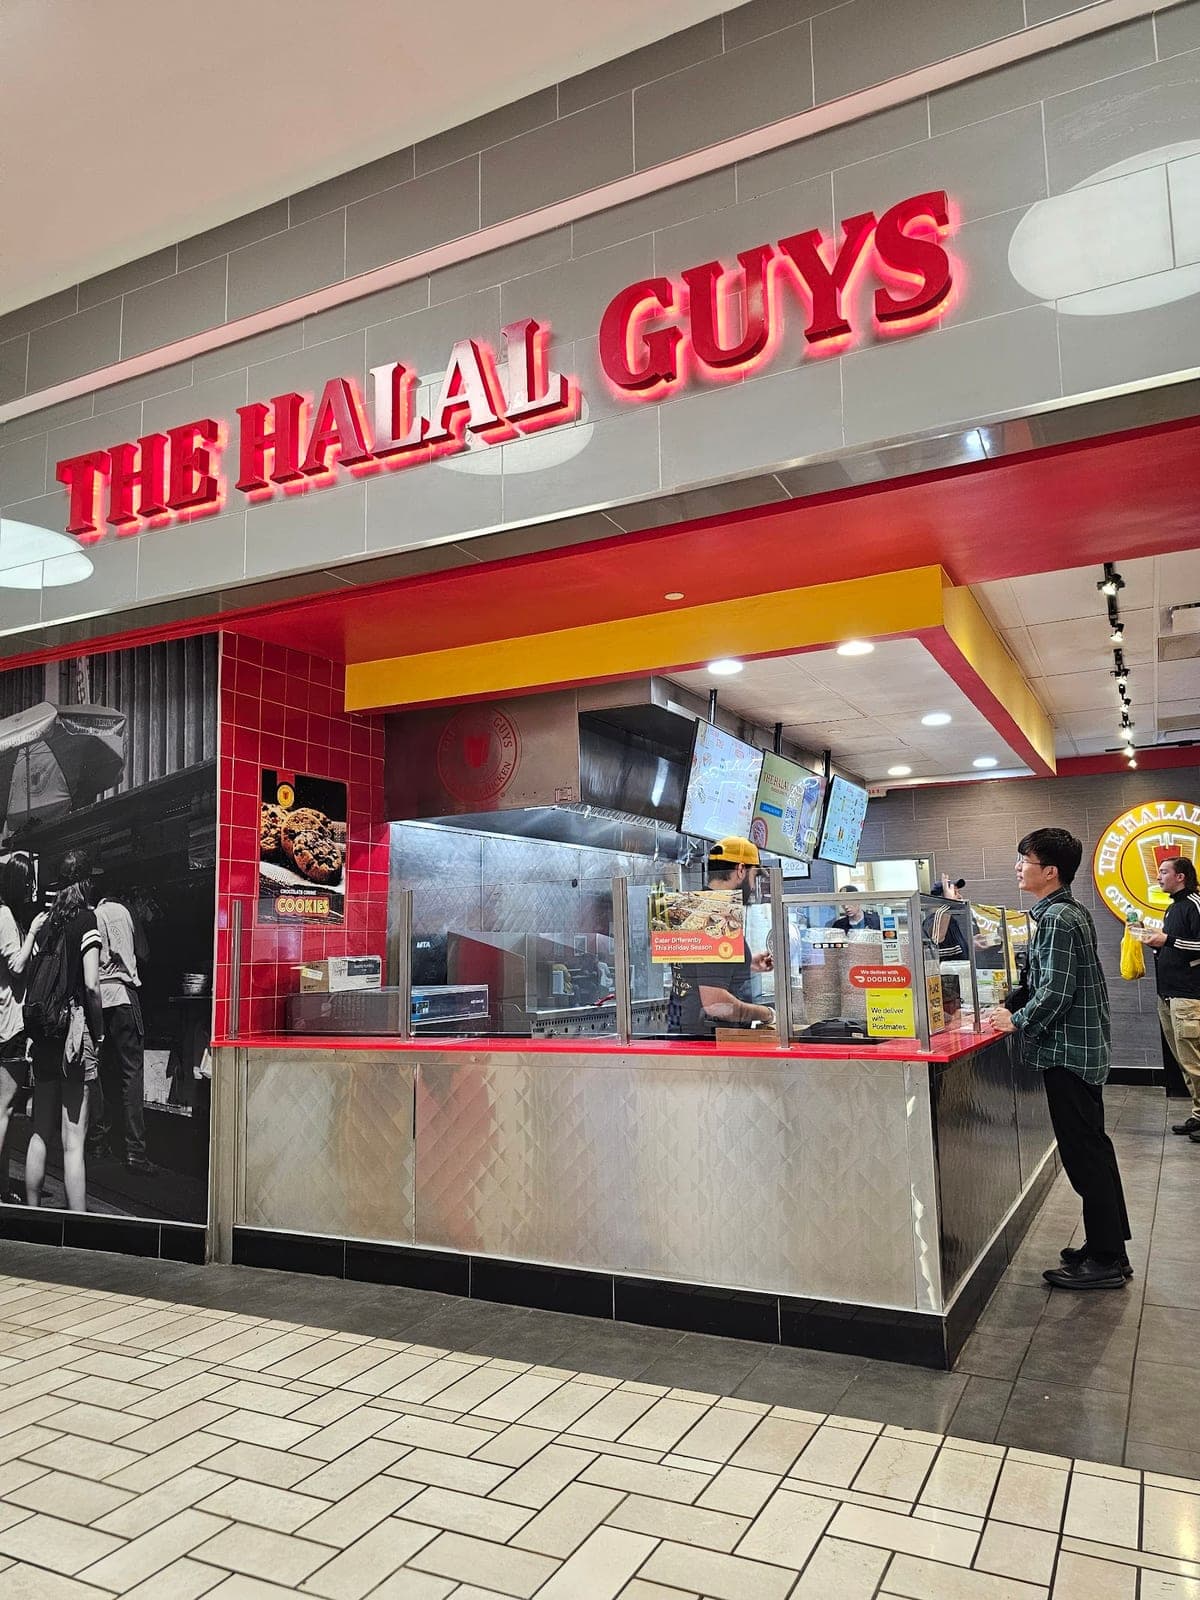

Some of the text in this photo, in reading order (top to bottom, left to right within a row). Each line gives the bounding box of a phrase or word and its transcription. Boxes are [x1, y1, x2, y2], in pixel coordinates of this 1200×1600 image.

[56, 190, 952, 535] THE HALAL GUYS
[493, 717, 513, 748] GUYS
[1098, 832, 1124, 876] THE
[277, 898, 329, 914] COOKIES
